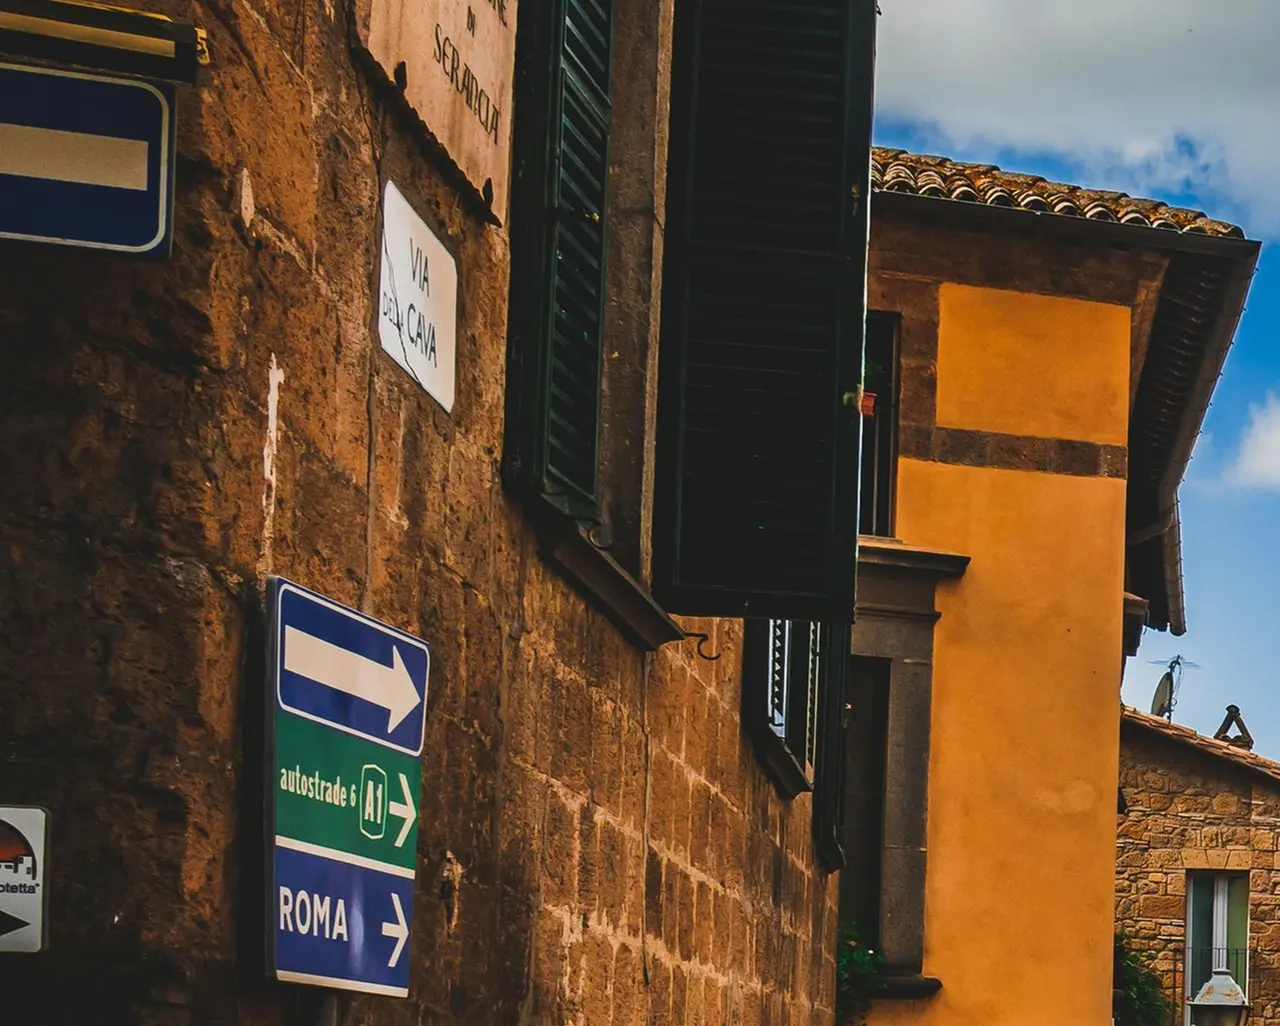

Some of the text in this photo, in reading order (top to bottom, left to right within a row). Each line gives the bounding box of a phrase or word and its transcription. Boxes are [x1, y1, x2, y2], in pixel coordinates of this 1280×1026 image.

[410, 238, 430, 298] VIA
[408, 303, 437, 368] CAVA
[281, 765, 383, 824] autostrade 6 A1
[280, 886, 348, 941] ROMA
